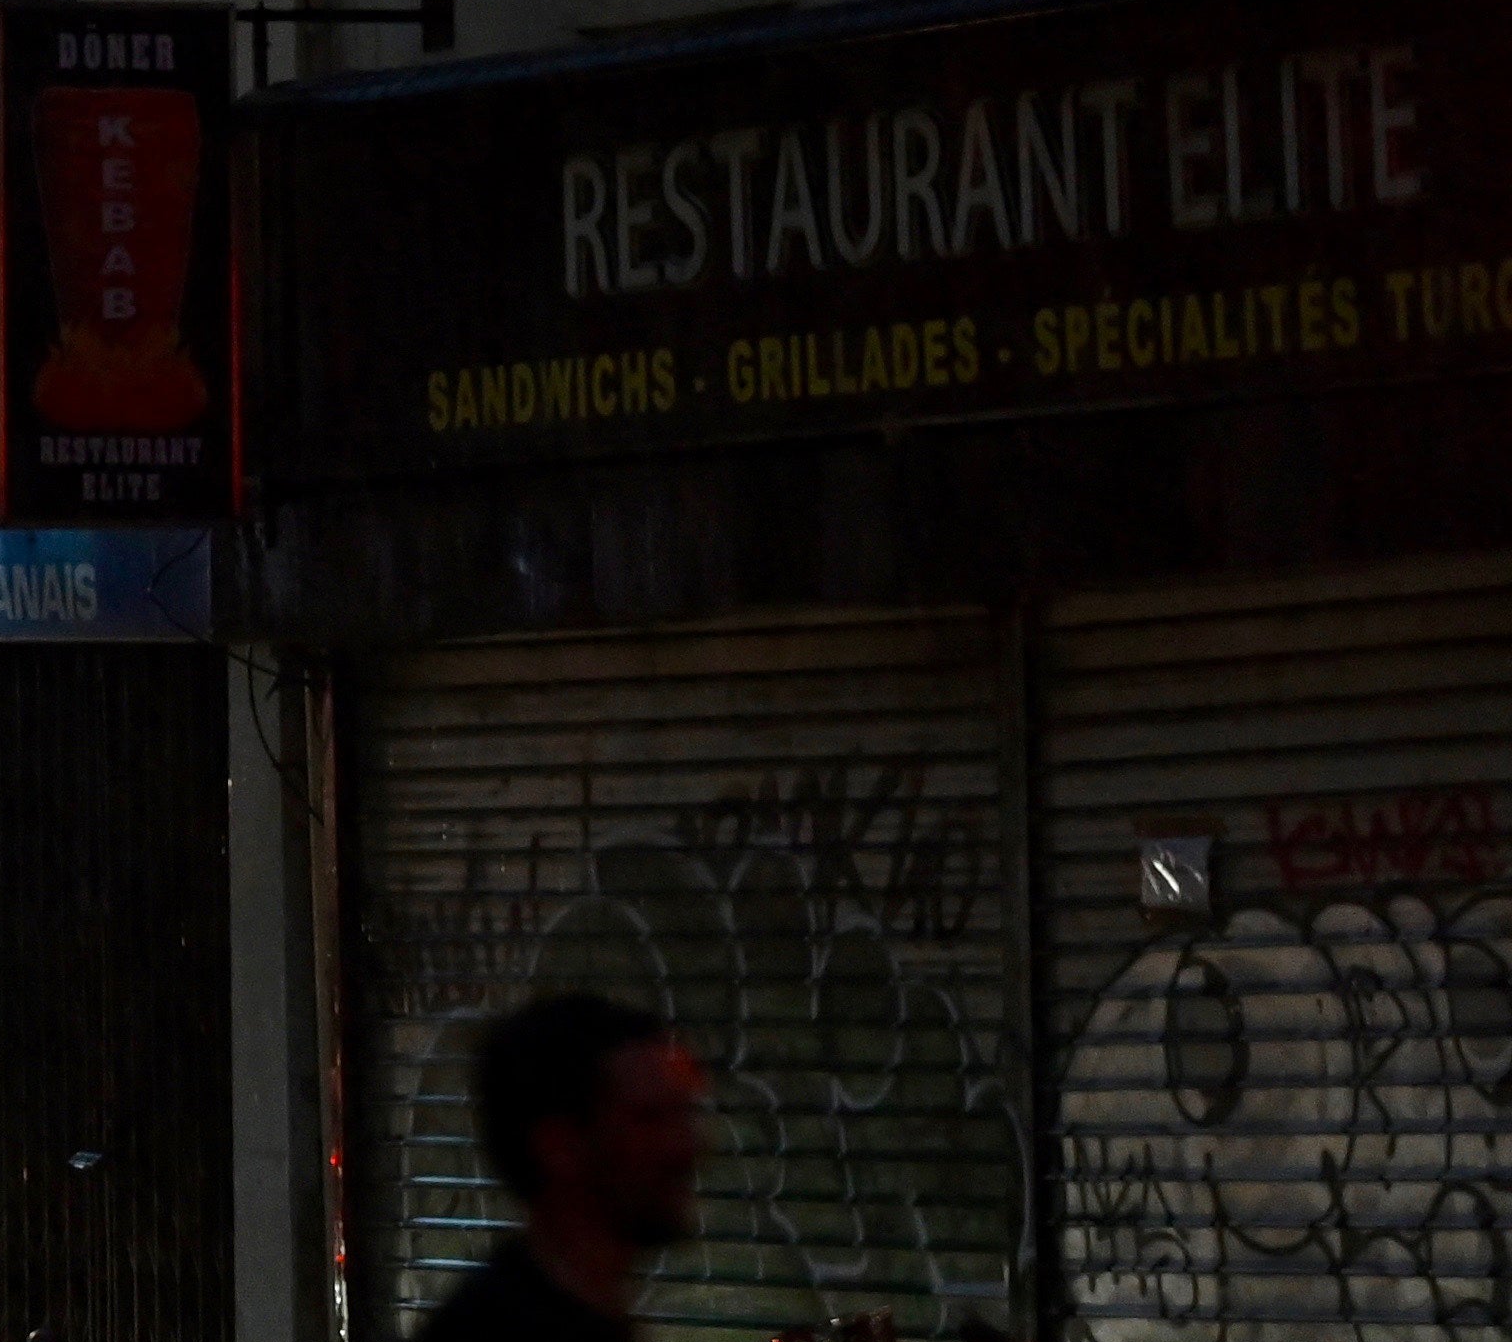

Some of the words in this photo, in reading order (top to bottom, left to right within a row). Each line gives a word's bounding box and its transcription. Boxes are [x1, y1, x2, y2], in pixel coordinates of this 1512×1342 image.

[97, 114, 137, 320] KEBAB
[560, 74, 1140, 300] RESTAURANT
[1164, 45, 1431, 233] ELITE
[426, 347, 678, 432] SANDWICHS
[727, 315, 980, 404] GRILLADES
[1034, 265, 1359, 376] SPÉCIALITÉS
[39, 436, 204, 466] RESTAURANT
[82, 471, 163, 503] ELITE
